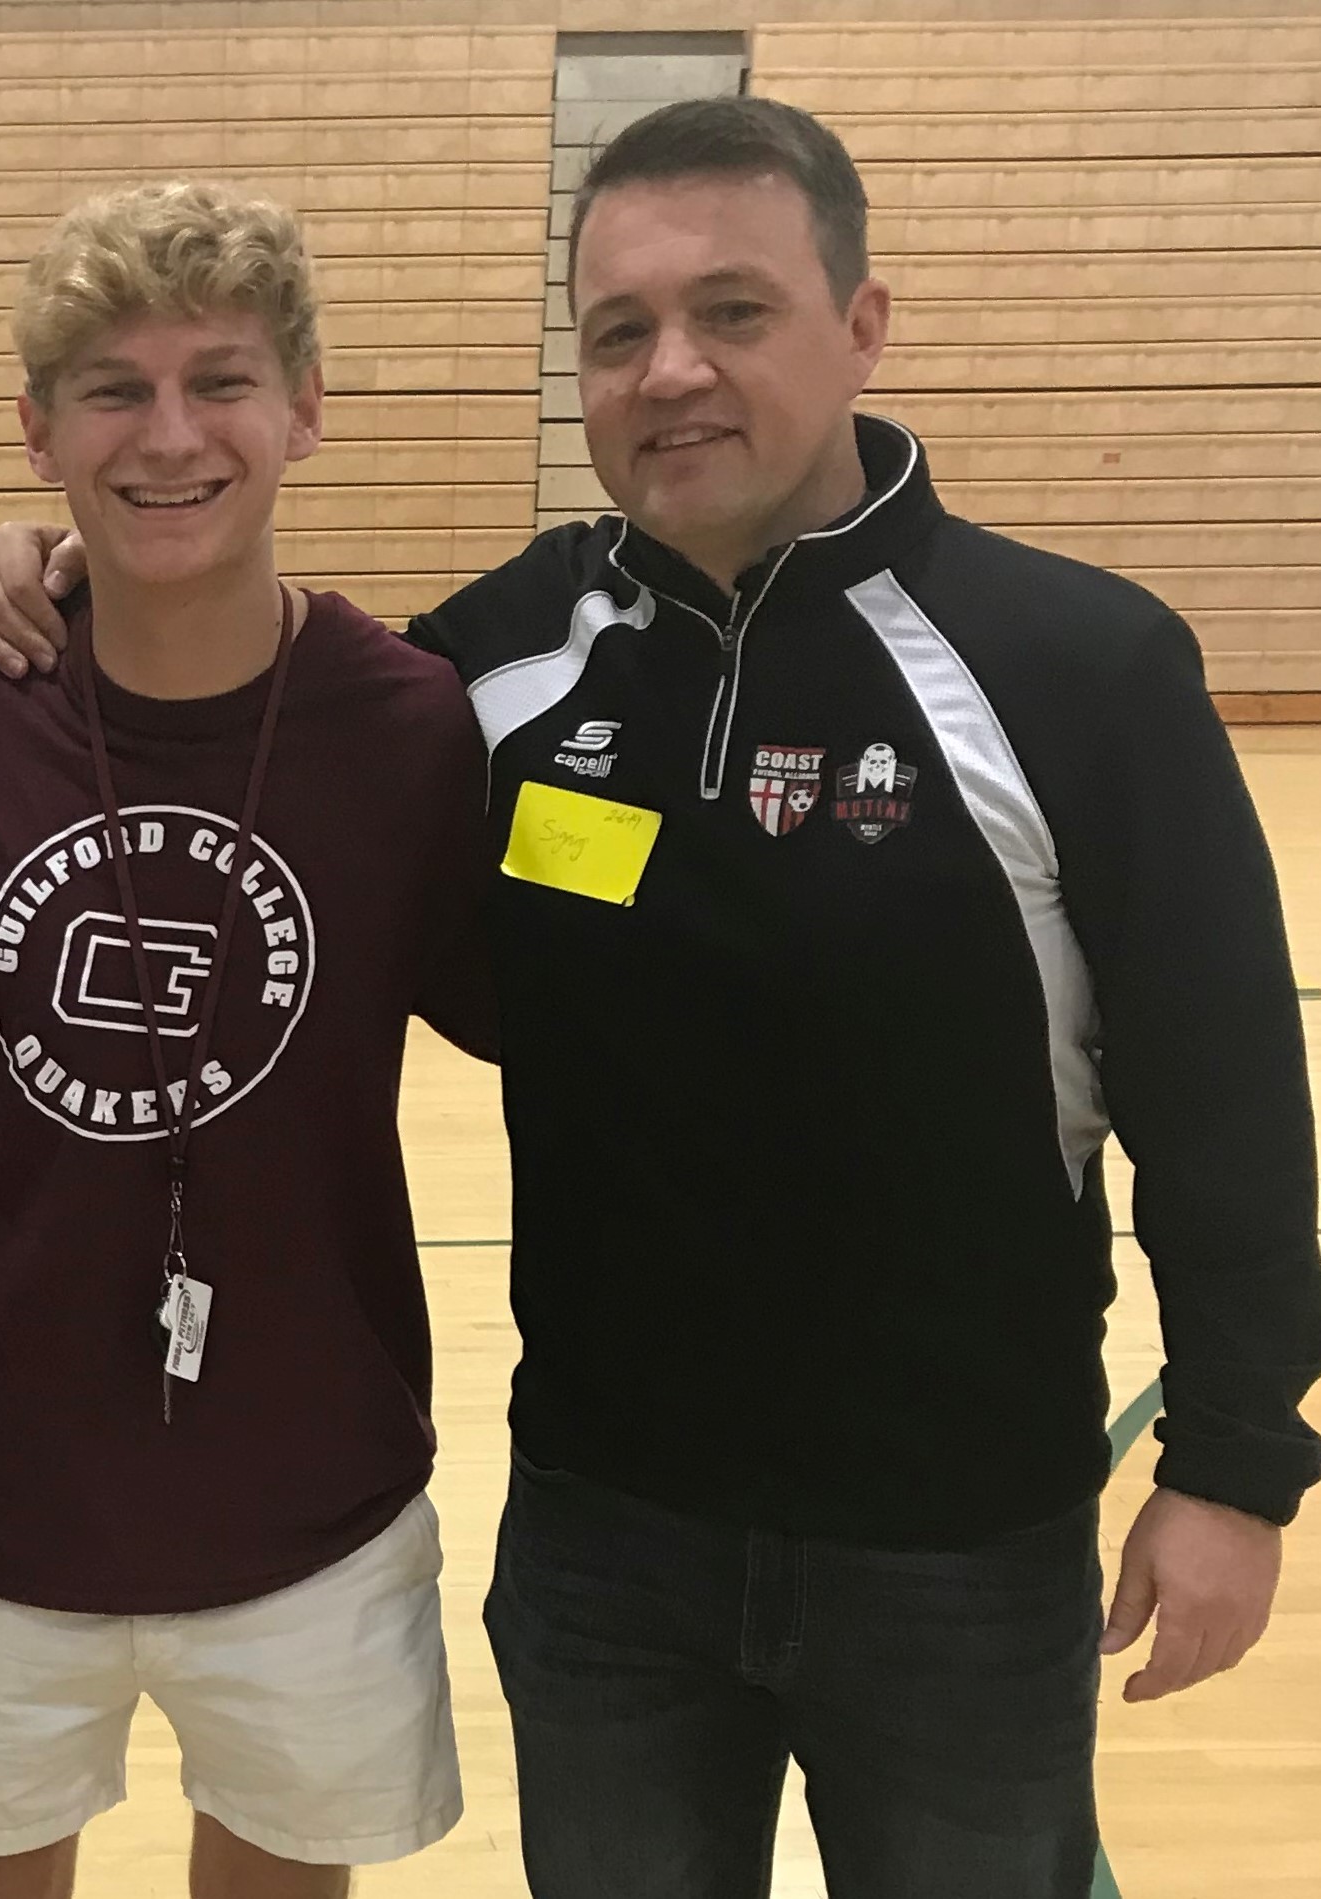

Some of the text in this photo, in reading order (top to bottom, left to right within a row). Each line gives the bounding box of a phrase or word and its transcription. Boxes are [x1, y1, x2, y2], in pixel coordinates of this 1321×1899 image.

[554, 752, 613, 773] capelli
[755, 750, 824, 771] COAST
[188, 828, 299, 1008] COLLEGE
[14, 1034, 232, 1126] QUAKERS
